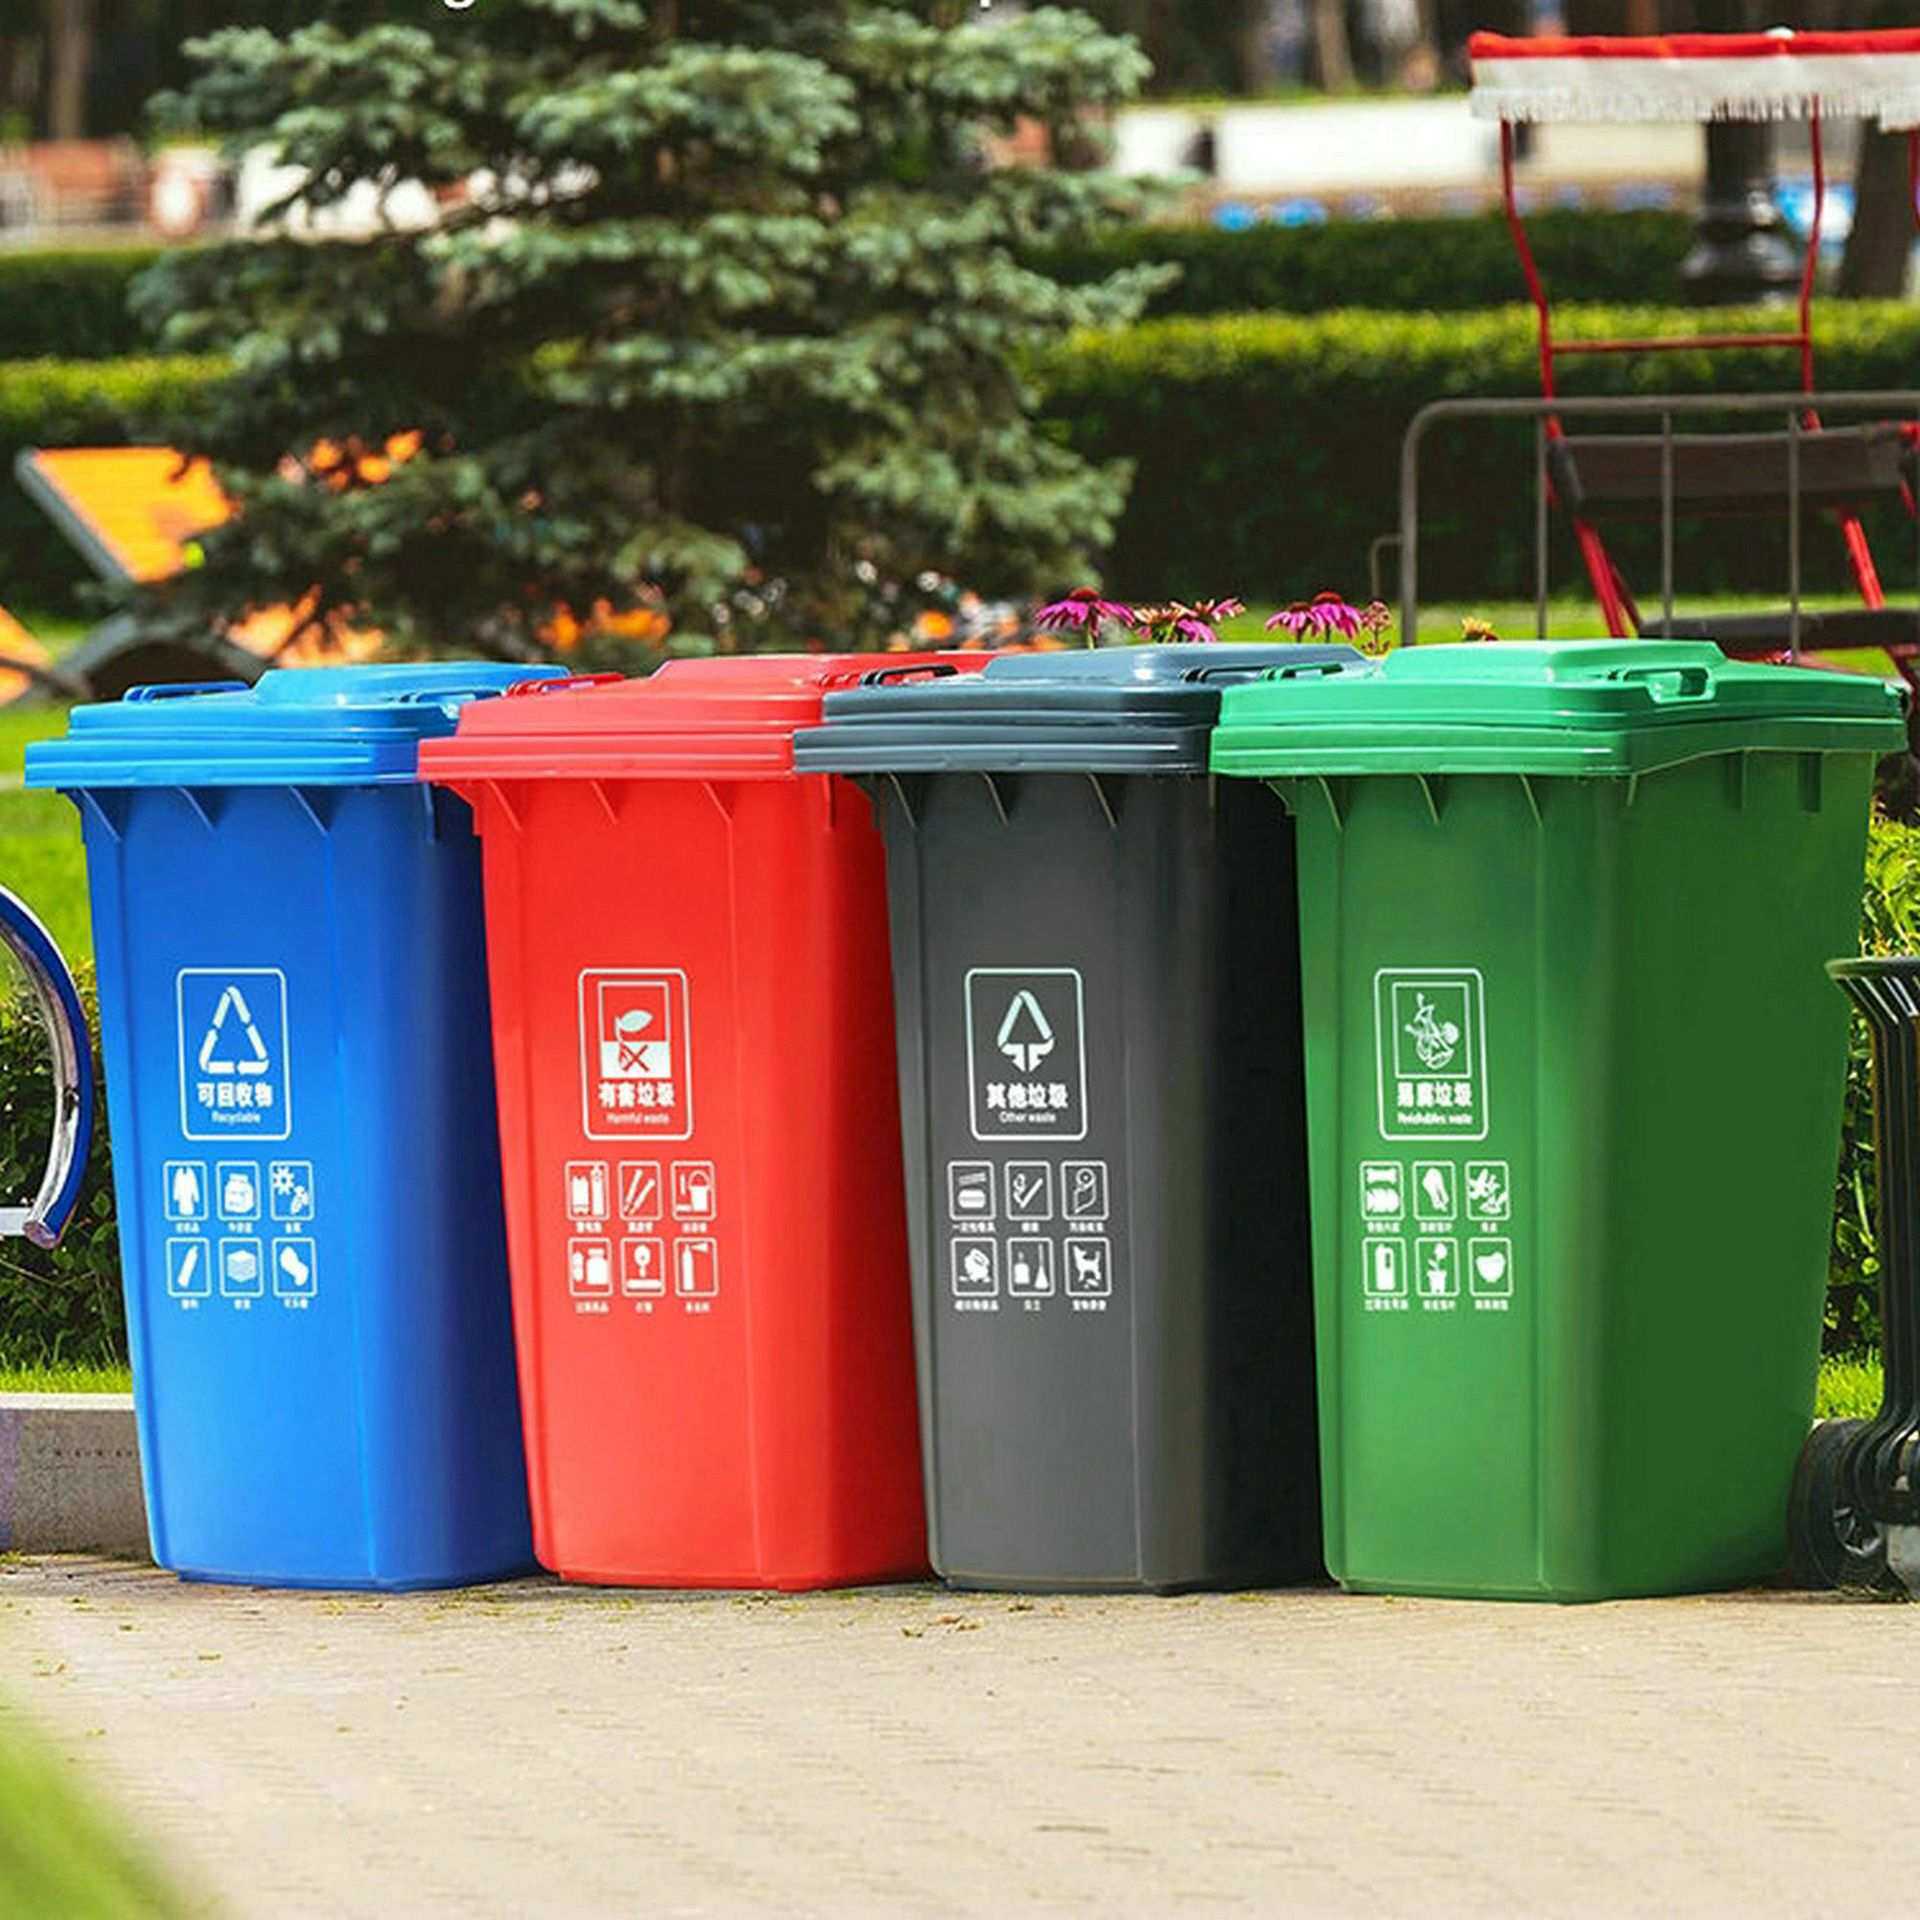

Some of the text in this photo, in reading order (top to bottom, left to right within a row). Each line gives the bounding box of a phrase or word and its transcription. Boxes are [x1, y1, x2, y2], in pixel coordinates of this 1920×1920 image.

[196, 1082, 273, 1108] 可回收物
[598, 1082, 675, 1108] 有害垃圾
[987, 1082, 1068, 1109] 其他垃圾
[999, 1111, 1056, 1123] Other waste
